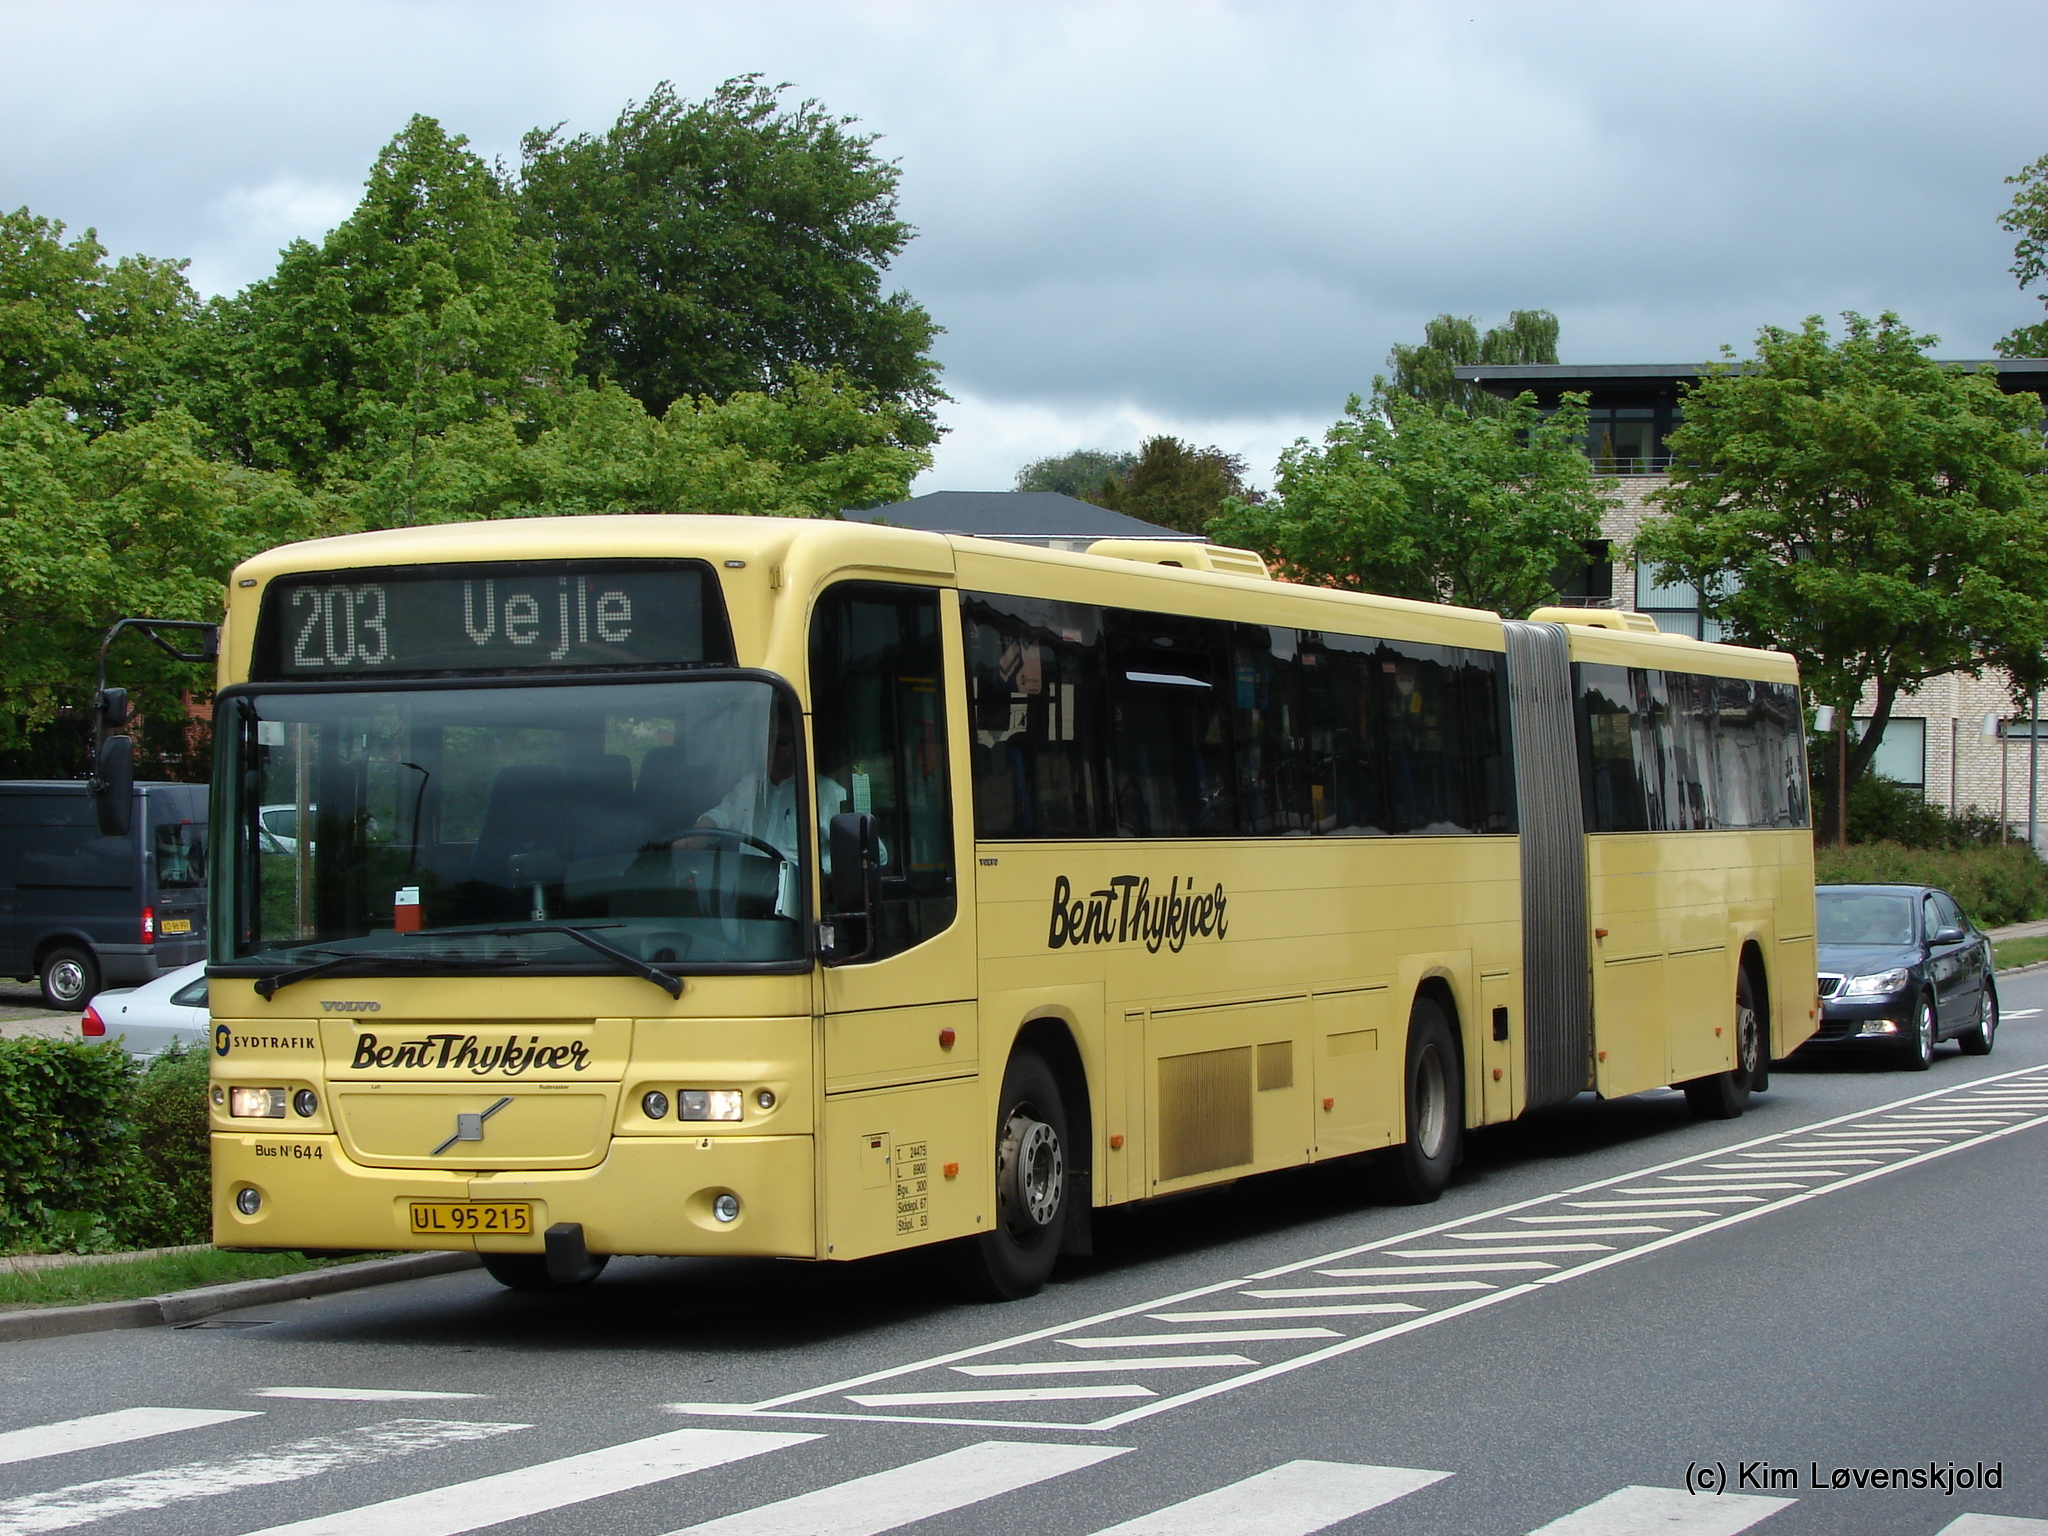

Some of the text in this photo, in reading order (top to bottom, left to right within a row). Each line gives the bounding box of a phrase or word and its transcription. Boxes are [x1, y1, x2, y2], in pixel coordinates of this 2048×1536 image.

[464, 576, 632, 660] Vejle
[1048, 875, 1229, 954] Bent Thykjær
[320, 1001, 381, 1012] VOLVO
[234, 1036, 315, 1049] SYDTRAFIK
[351, 1033, 592, 1076] Bent Thykjær
[255, 1144, 277, 1157] Bus
[293, 1145, 324, 1160] 644
[414, 1208, 446, 1229] UL
